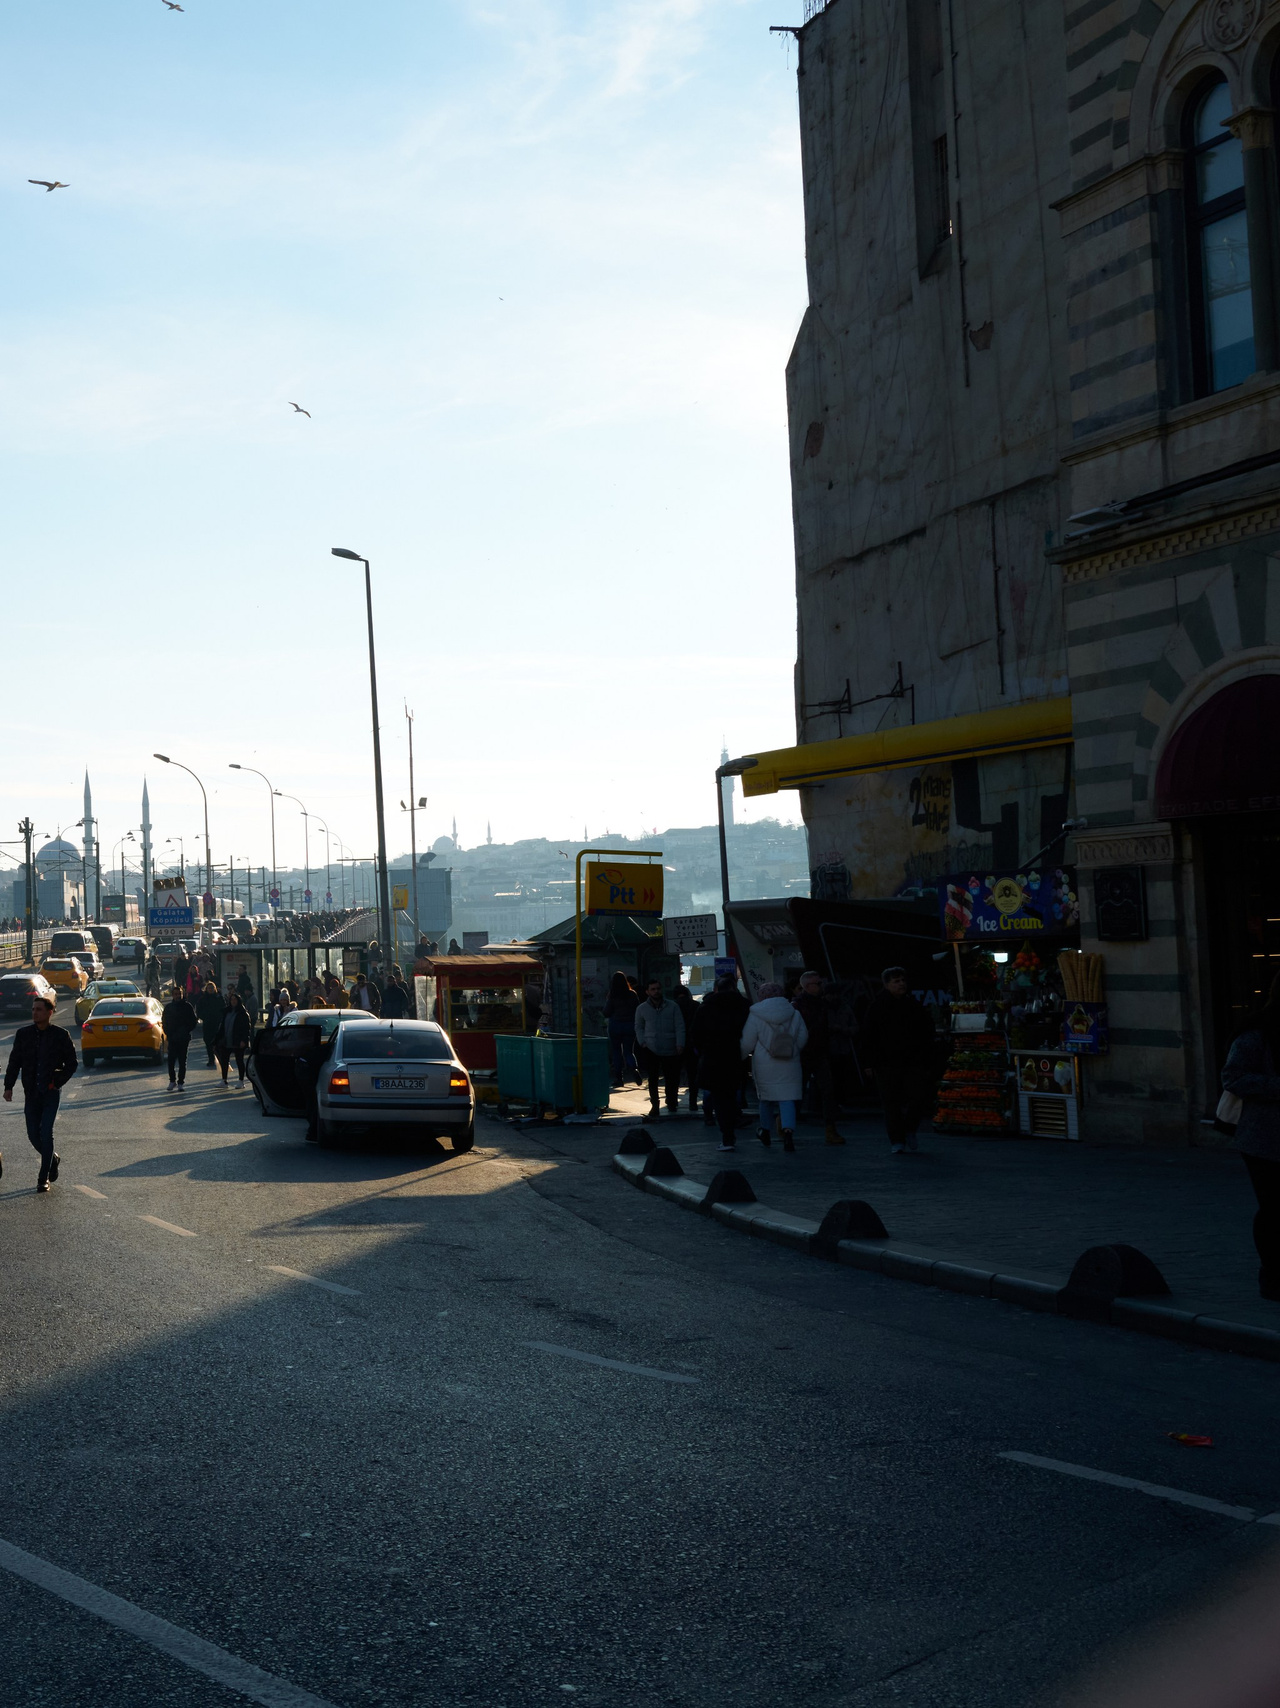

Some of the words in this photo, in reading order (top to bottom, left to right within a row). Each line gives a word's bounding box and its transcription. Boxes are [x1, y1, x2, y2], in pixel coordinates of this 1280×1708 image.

[610, 886, 635, 905] Ptt
[673, 917, 709, 925] Karaköy
[977, 915, 999, 931] Ice
[999, 914, 1044, 931] Cream
